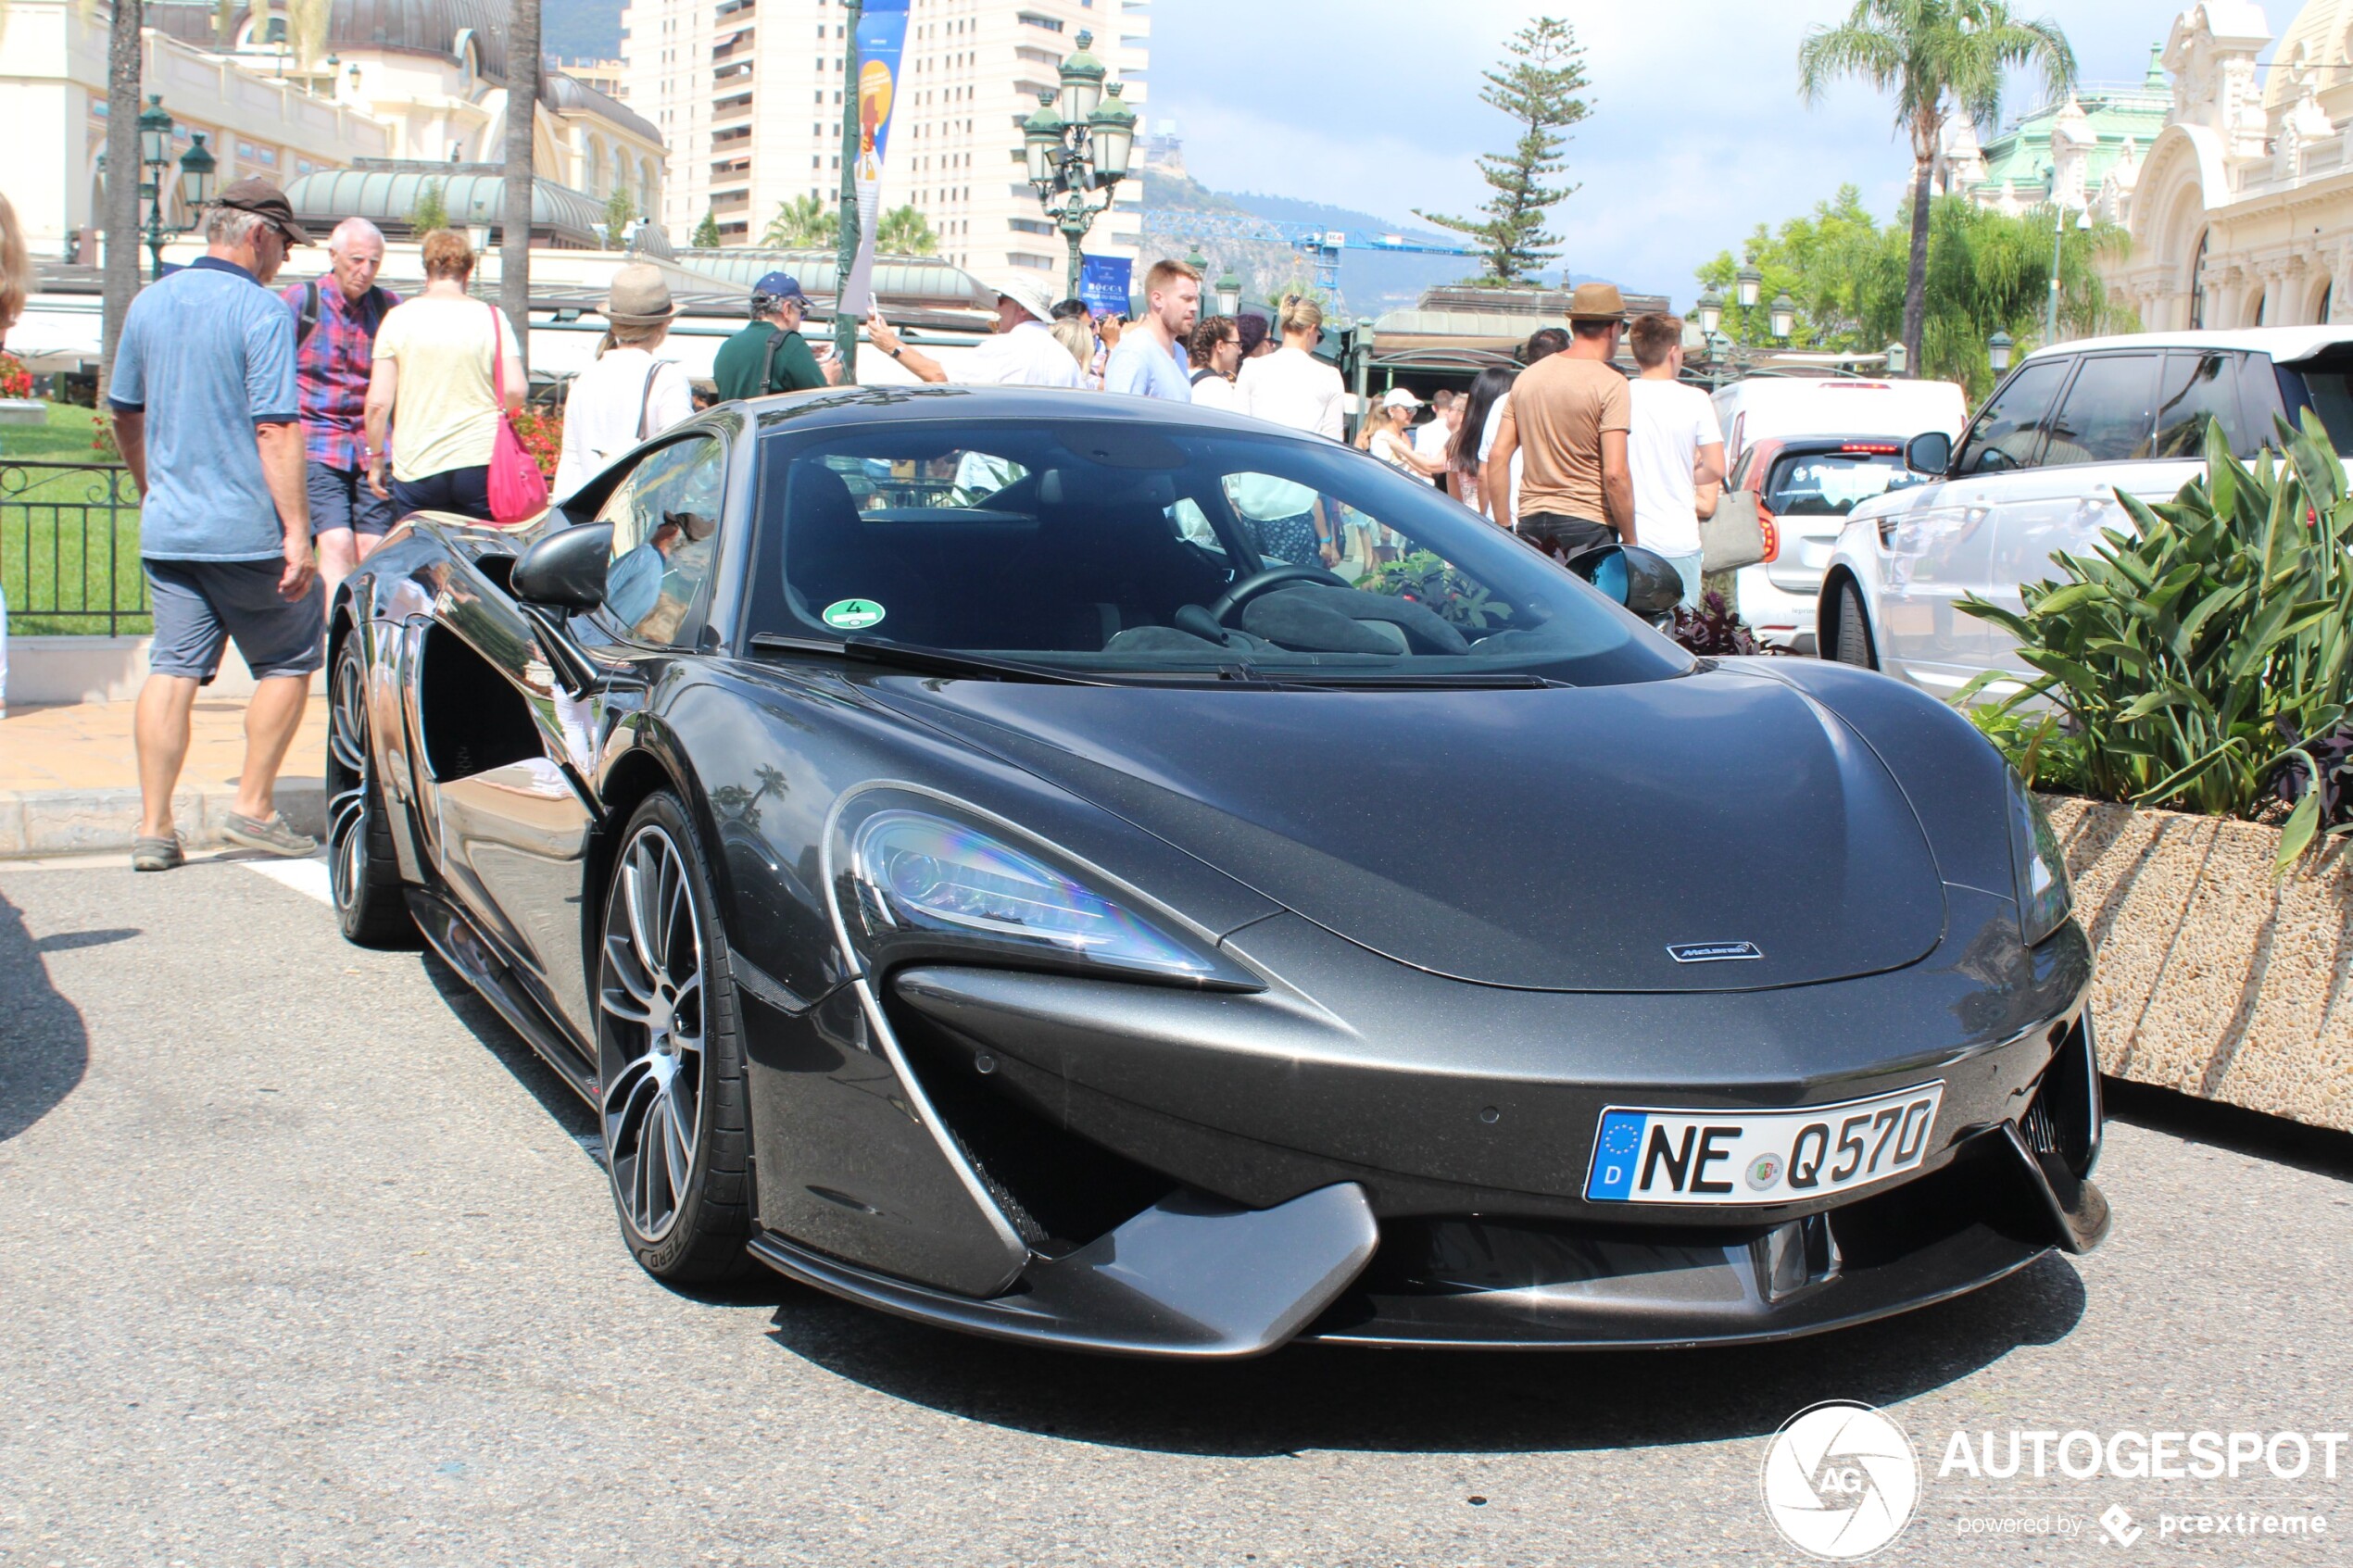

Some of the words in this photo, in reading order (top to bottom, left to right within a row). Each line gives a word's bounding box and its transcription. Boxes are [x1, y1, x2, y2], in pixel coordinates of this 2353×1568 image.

[846, 601, 862, 613] 4
[1681, 946, 1748, 957] McLaren
[1639, 1123, 1743, 1194] NE
[1786, 1098, 1932, 1190] Q570
[1604, 1164, 1623, 1185] D
[650, 1231, 684, 1269] ZERO
